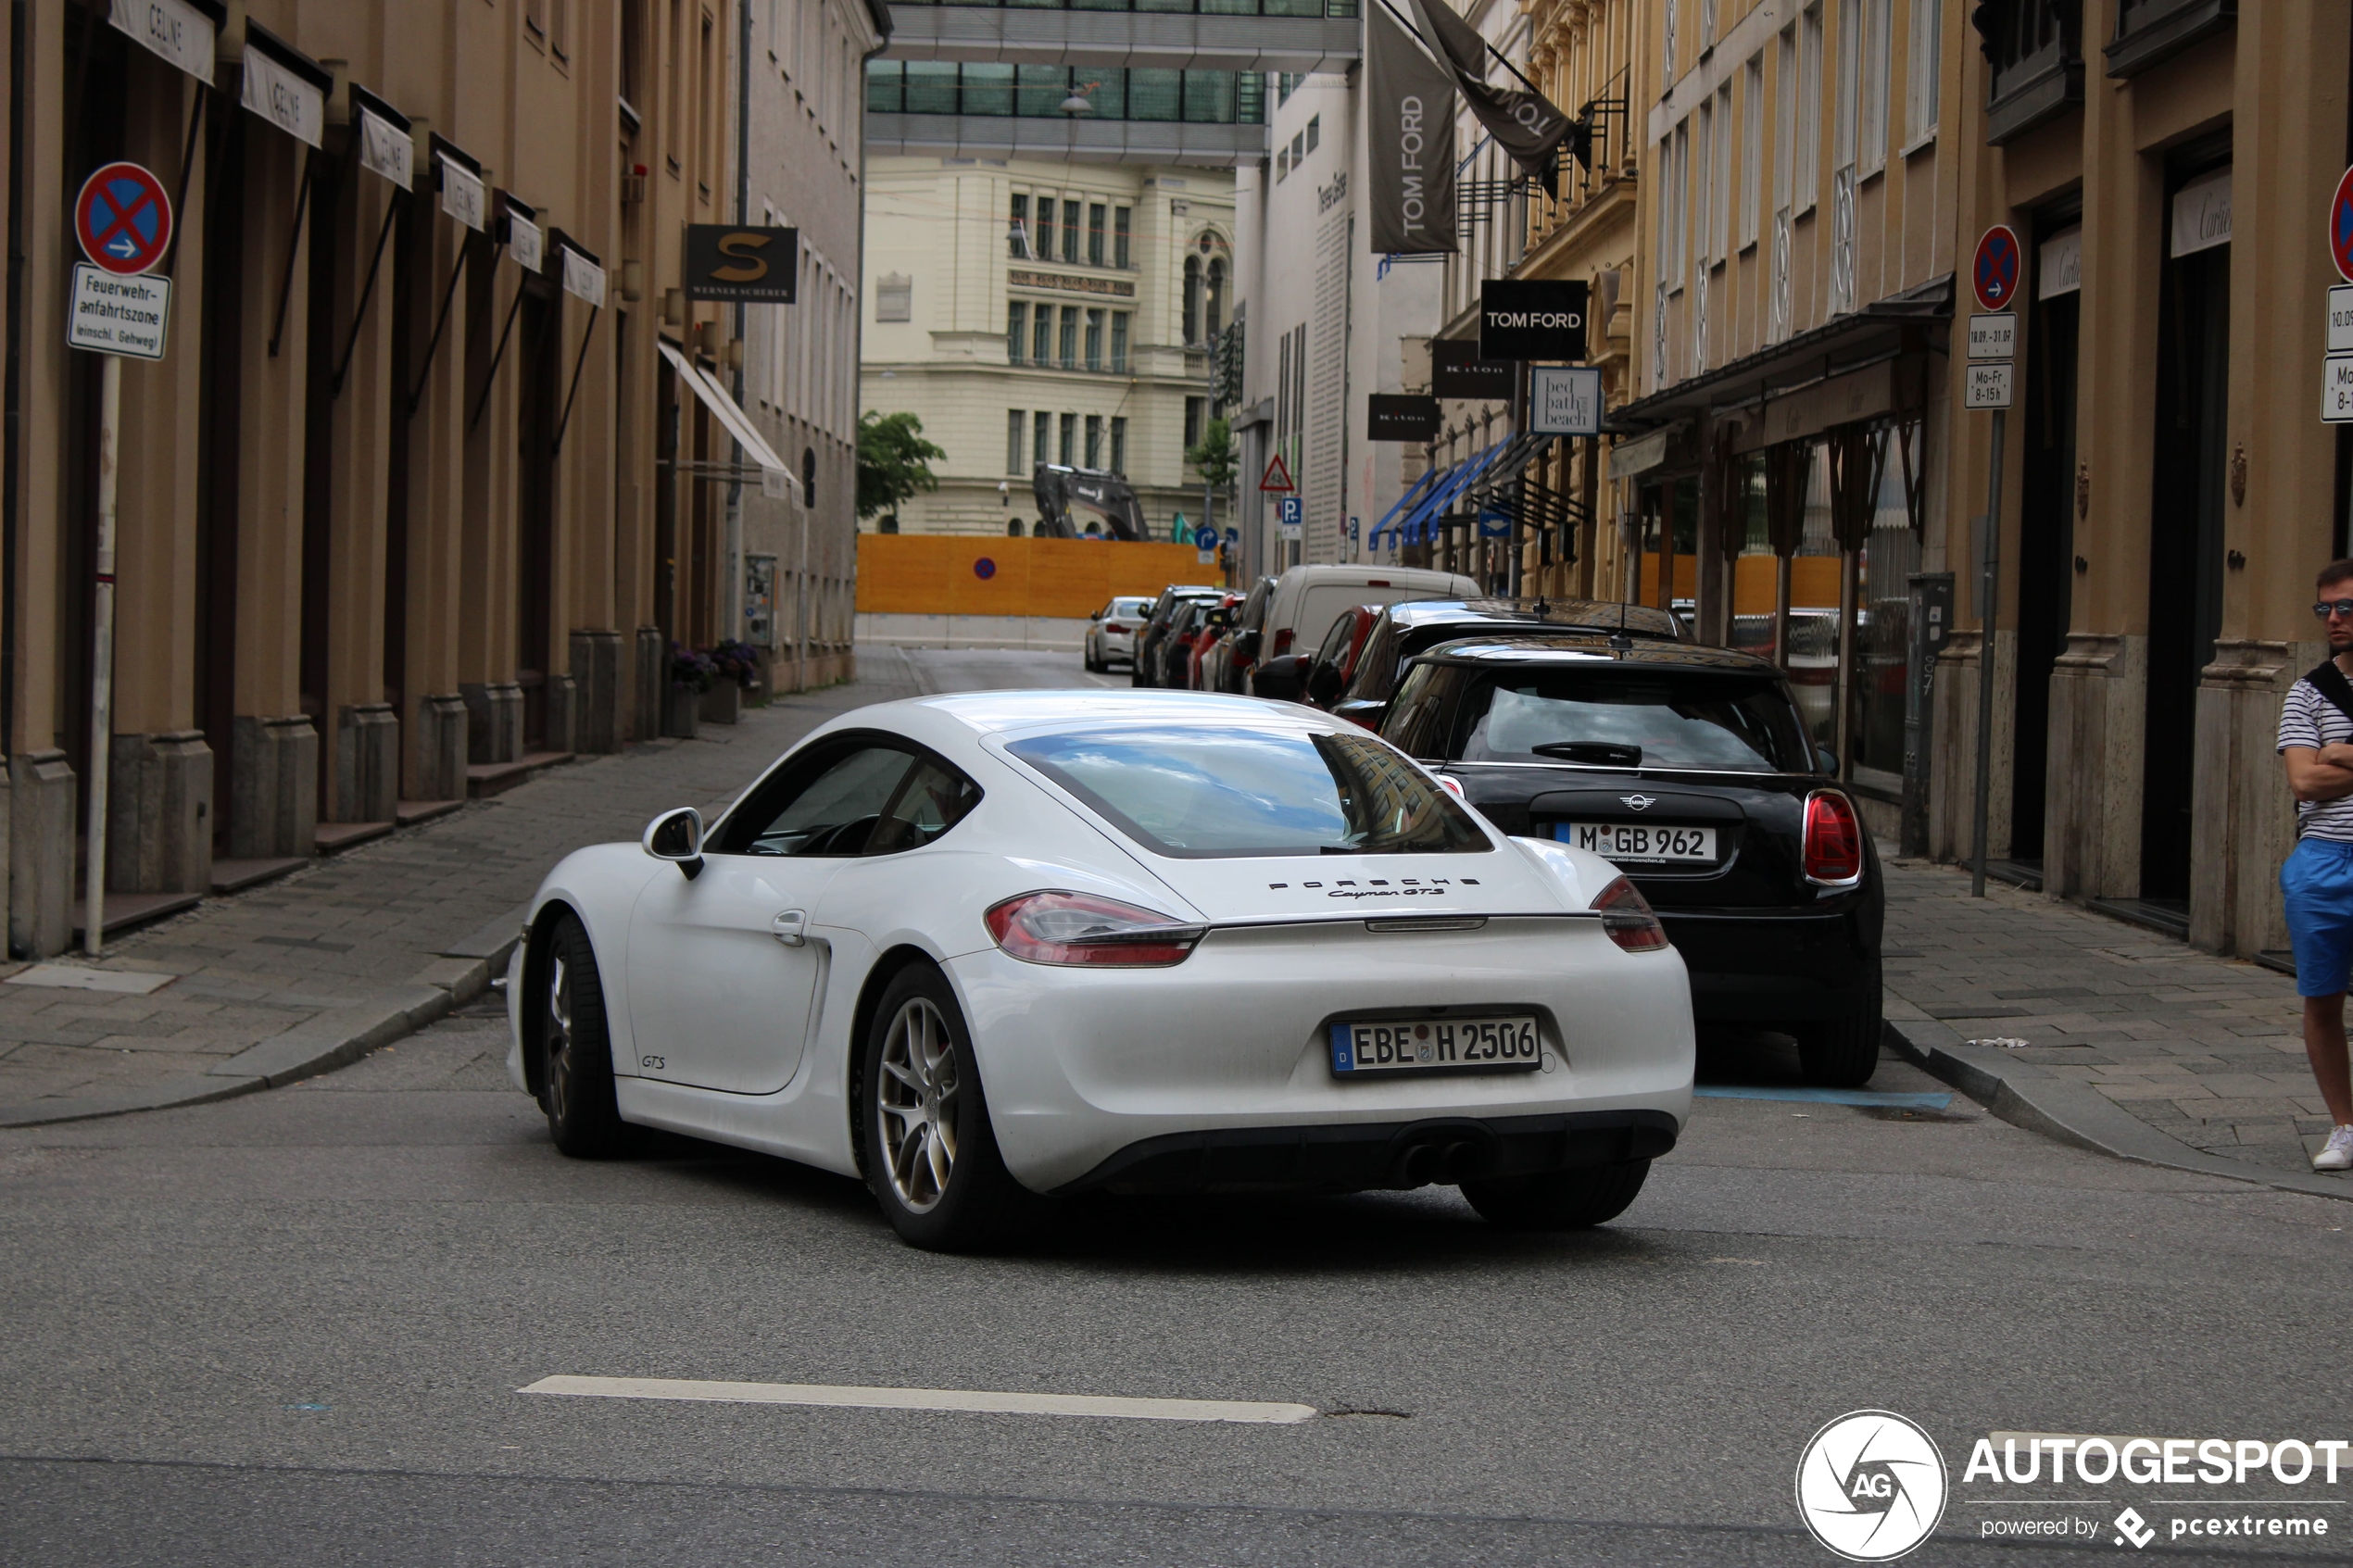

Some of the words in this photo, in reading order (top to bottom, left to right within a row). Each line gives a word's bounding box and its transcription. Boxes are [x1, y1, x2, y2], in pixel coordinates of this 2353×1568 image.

[149, 3, 182, 53] CELINE
[272, 82, 300, 123] CELINE
[1494, 90, 1550, 139] TOM
[1401, 95, 1424, 170] FORD
[1402, 175, 1425, 237] TOM
[85, 275, 157, 300] Feuerwehr-
[693, 285, 736, 295] WERNER
[740, 288, 787, 297] SCHERER
[80, 299, 159, 325] anfahrtszone
[1487, 312, 1527, 328] TOM
[1530, 313, 1580, 328] FORD
[76, 323, 114, 341] (einschl.
[119, 330, 157, 350] Gehweg)
[1445, 361, 1504, 374] Kiton
[1975, 370, 2003, 384] Mo-Fr
[1545, 376, 1574, 395] bed
[1545, 393, 1579, 410] bath
[1378, 411, 1426, 422] Kiton
[1544, 408, 1586, 426] beach
[1285, 500, 1297, 521] P
[1579, 826, 1597, 852] M
[1616, 827, 1649, 854] GB
[1655, 830, 1705, 857] 962
[1268, 878, 1480, 890] PORSCHE
[1327, 890, 1400, 900] Cayman
[1354, 1026, 1415, 1065] EBE
[1436, 1024, 1456, 1061] H
[1462, 1022, 1535, 1061] 2506
[642, 1055, 666, 1070] GTS
[1340, 1052, 1347, 1063] D
